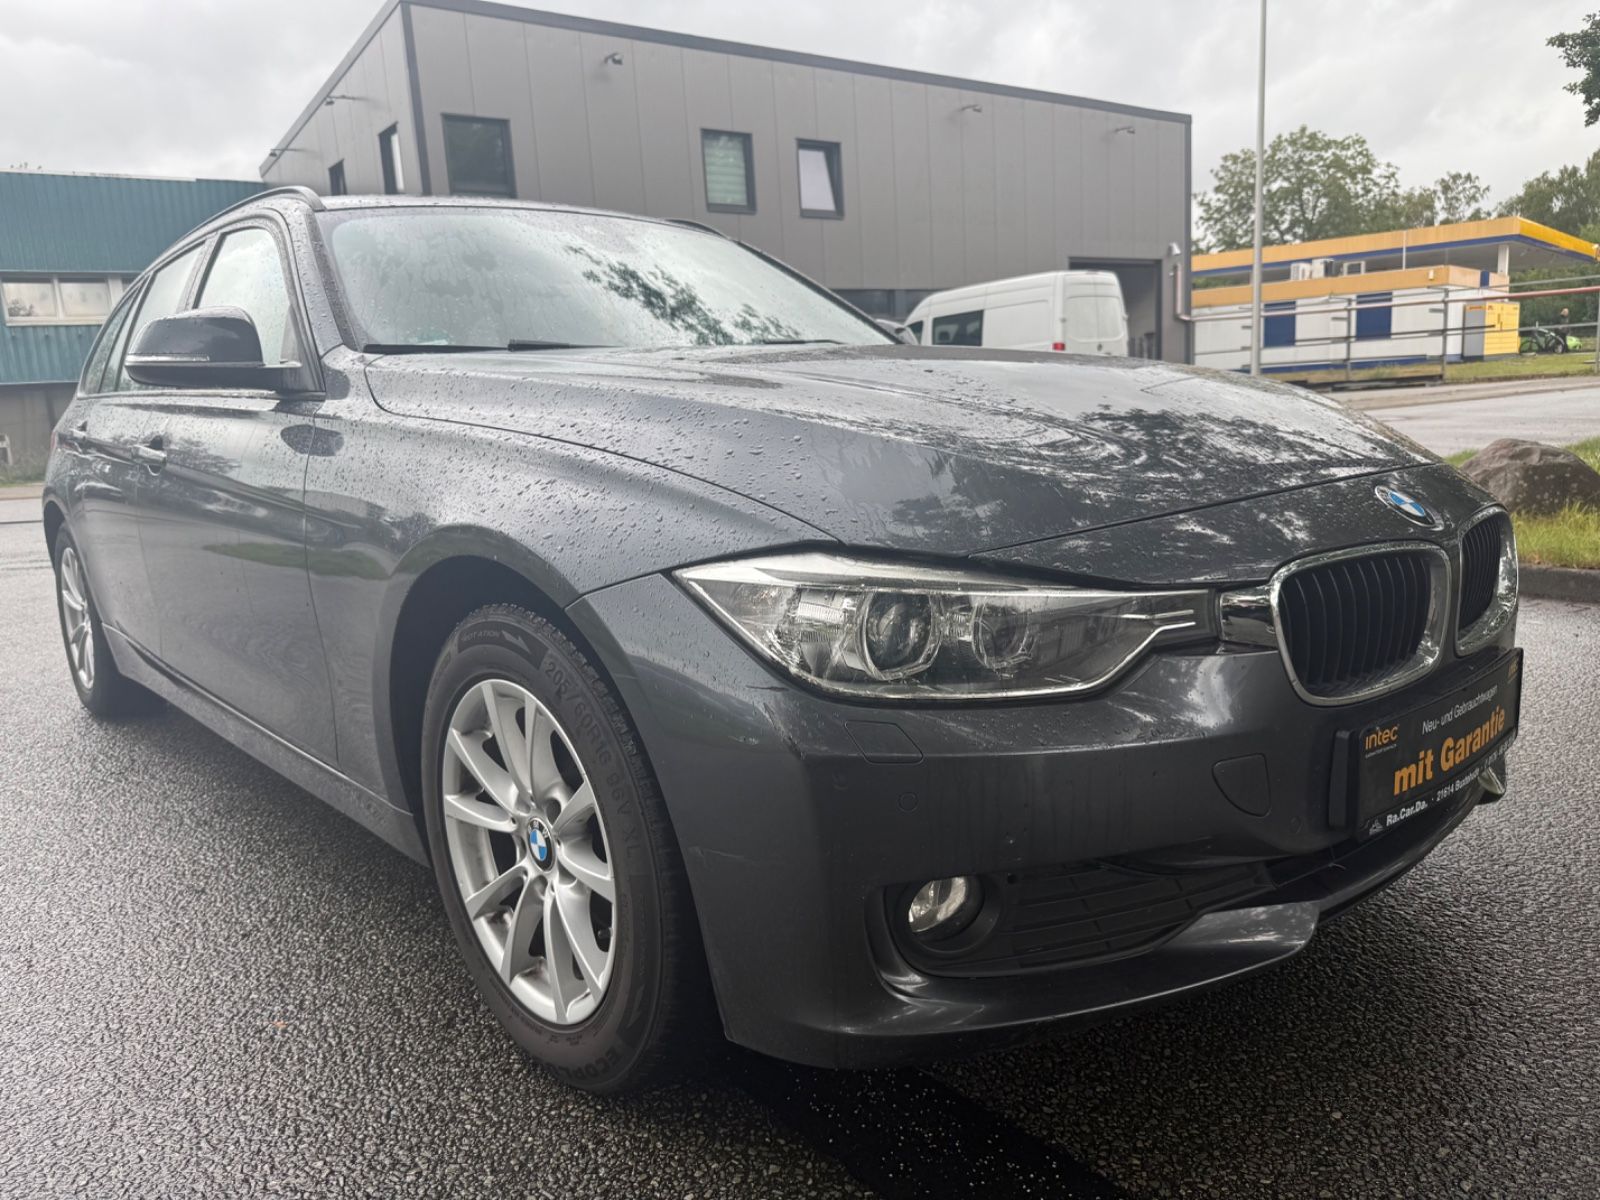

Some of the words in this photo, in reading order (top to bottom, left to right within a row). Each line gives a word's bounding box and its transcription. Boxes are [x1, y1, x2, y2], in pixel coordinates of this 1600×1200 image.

[1422, 719, 1440, 735] Neu-
[1441, 706, 1453, 726] und
[1365, 726, 1398, 750] intec
[1394, 749, 1434, 796] mit
[1441, 705, 1505, 771] Garantie
[1386, 801, 1428, 826] Ra.Car.Da.
